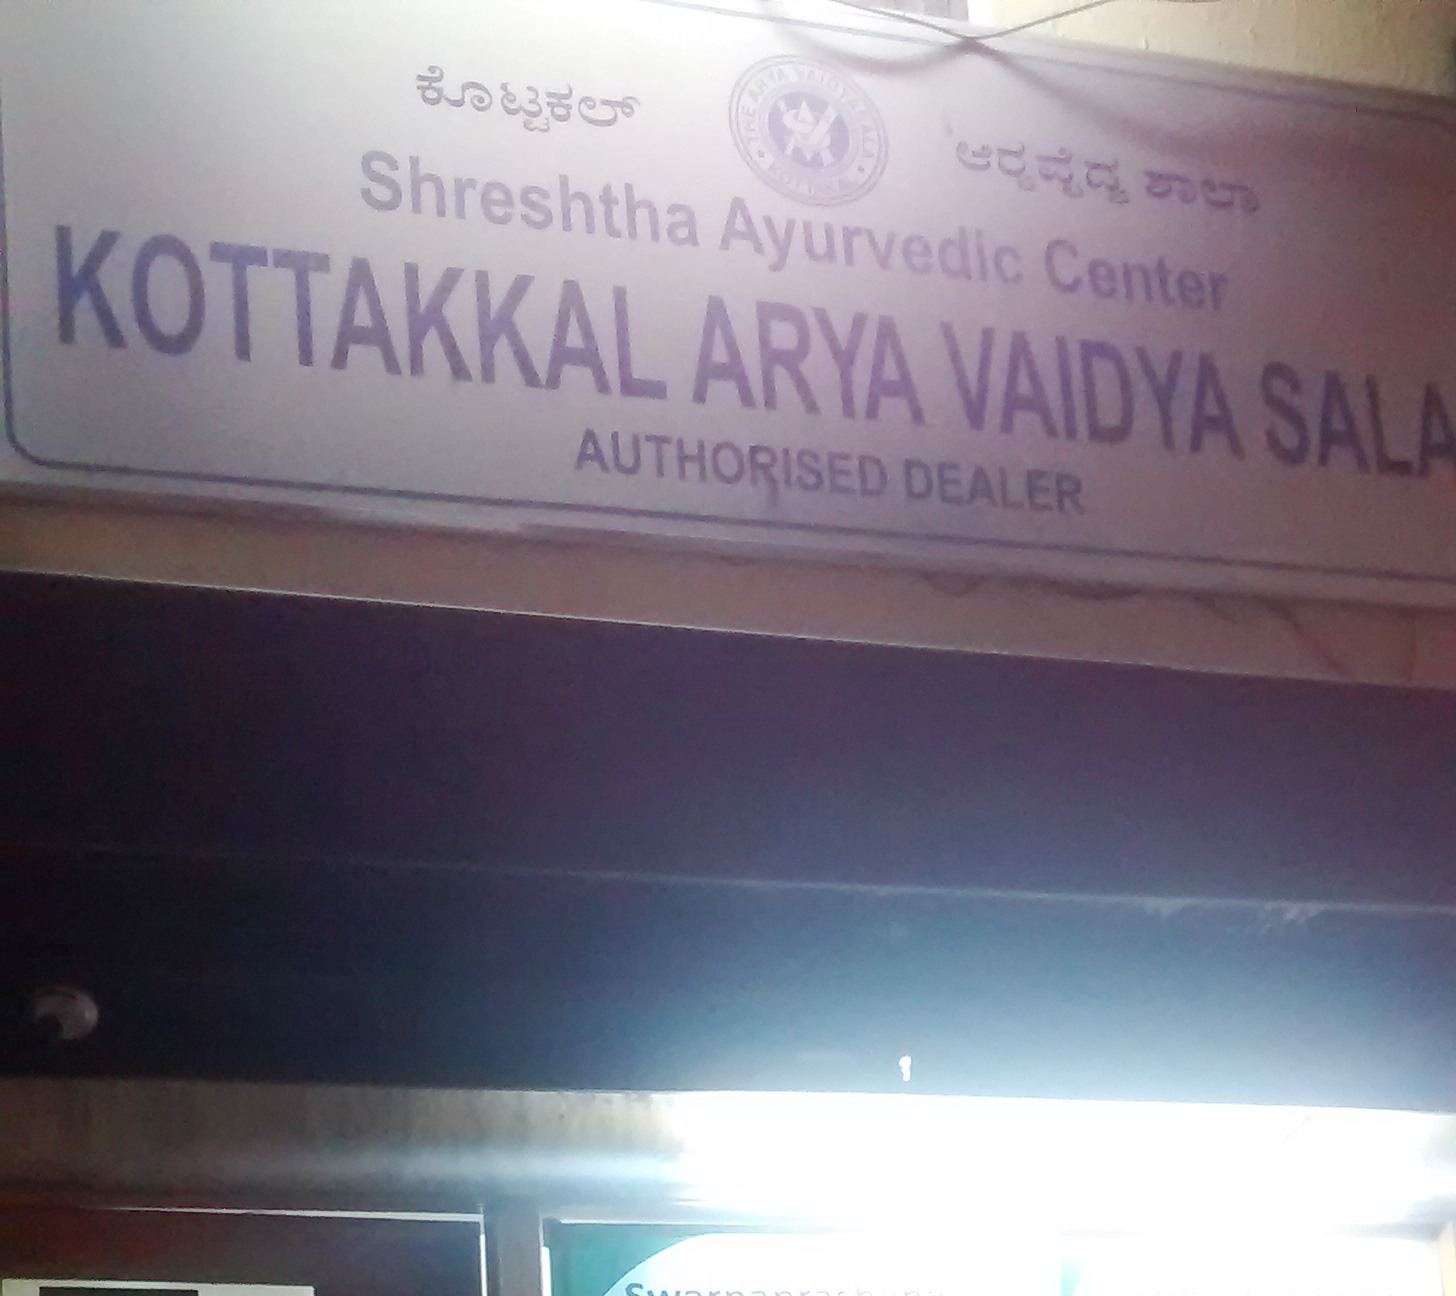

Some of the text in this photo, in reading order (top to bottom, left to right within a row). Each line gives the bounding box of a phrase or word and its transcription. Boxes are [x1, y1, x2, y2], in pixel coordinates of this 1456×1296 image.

[360, 150, 1230, 313] Shreshtha Ayurvedic Center
[55, 224, 1456, 480] KOTTAKKAL ARYA VAIDYA SALA
[574, 428, 1086, 515] AUTHORISED DEALER
